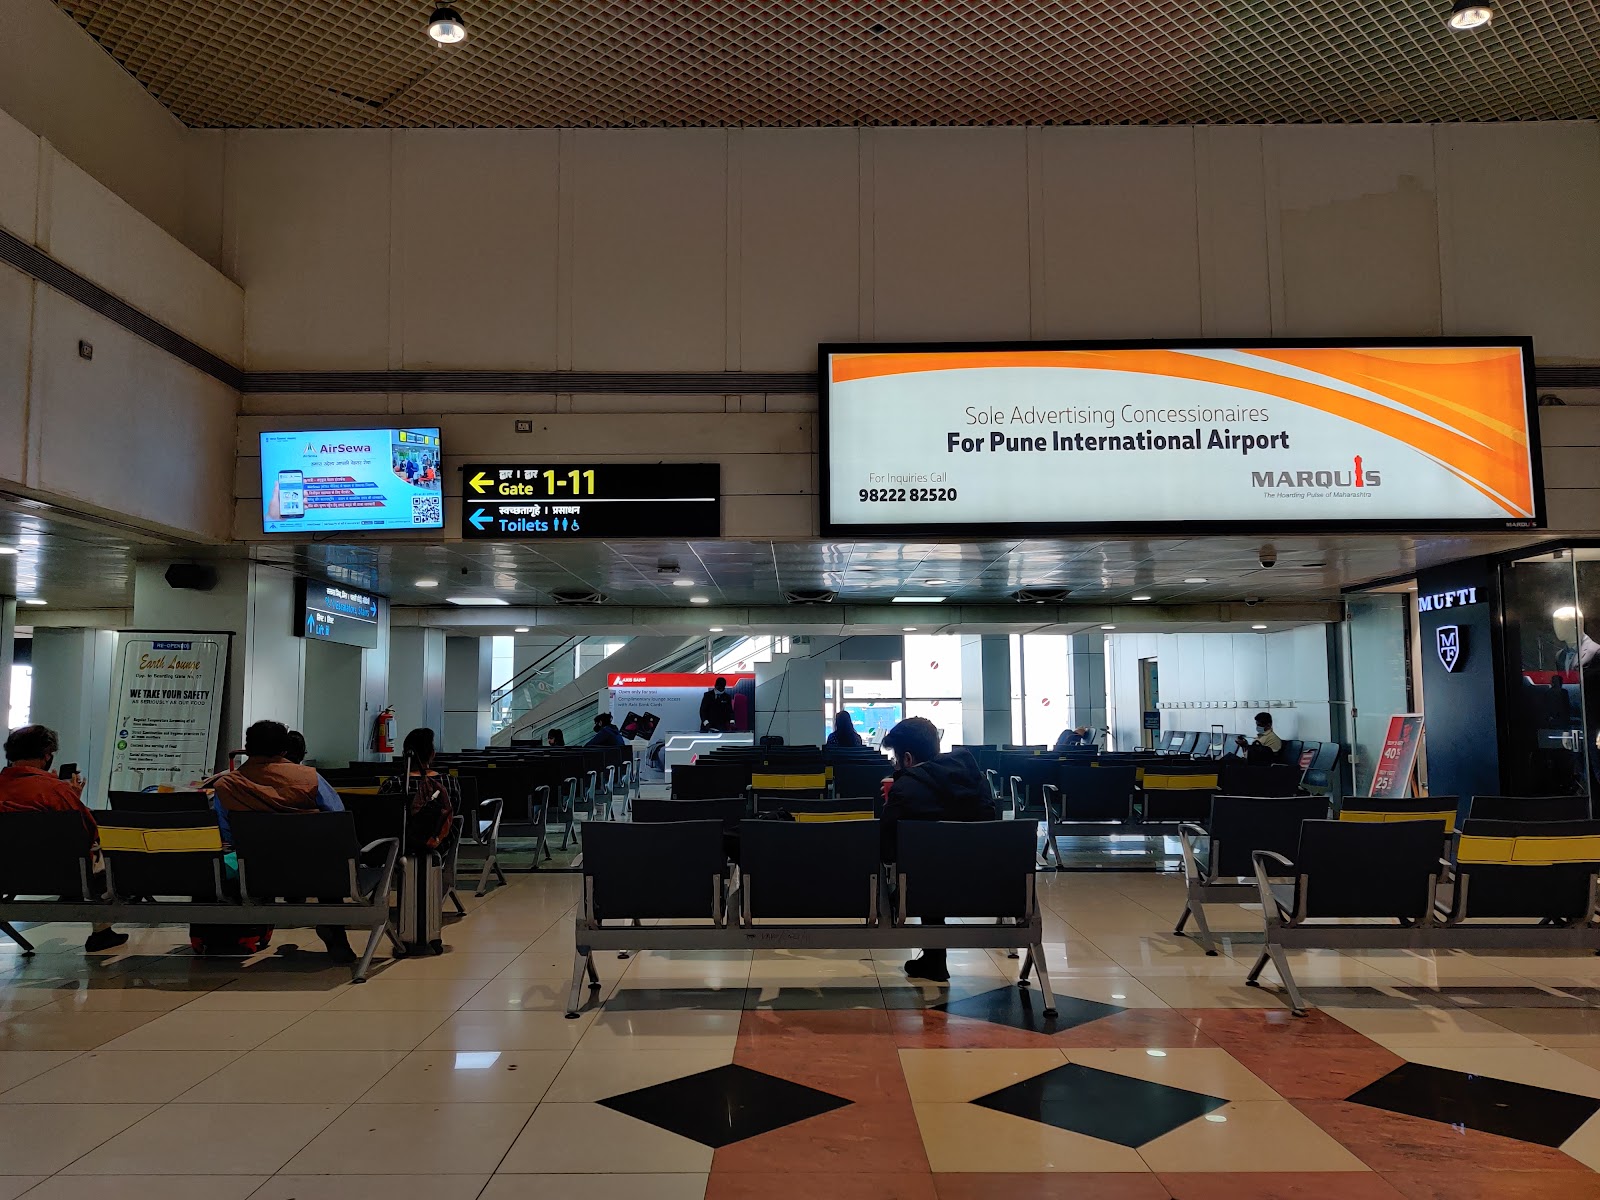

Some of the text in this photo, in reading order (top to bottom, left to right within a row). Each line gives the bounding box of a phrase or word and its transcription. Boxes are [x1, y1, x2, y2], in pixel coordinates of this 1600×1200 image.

[965, 404, 1269, 429] Sole Advertising Concessionaires
[320, 443, 371, 454] AirSewa
[947, 428, 1290, 455] For Pune International Airport
[869, 472, 947, 485] For Inquiries Call
[1251, 454, 1382, 489] MARQUIS
[499, 470, 594, 495] Gate 1-11
[859, 487, 957, 502] 98222 82520
[499, 518, 549, 531] Toilets
[1418, 587, 1477, 613] MUFTI
[140, 653, 200, 674] Earth Lounge
[130, 689, 210, 700] WE TAKE YOUR SAFETY
